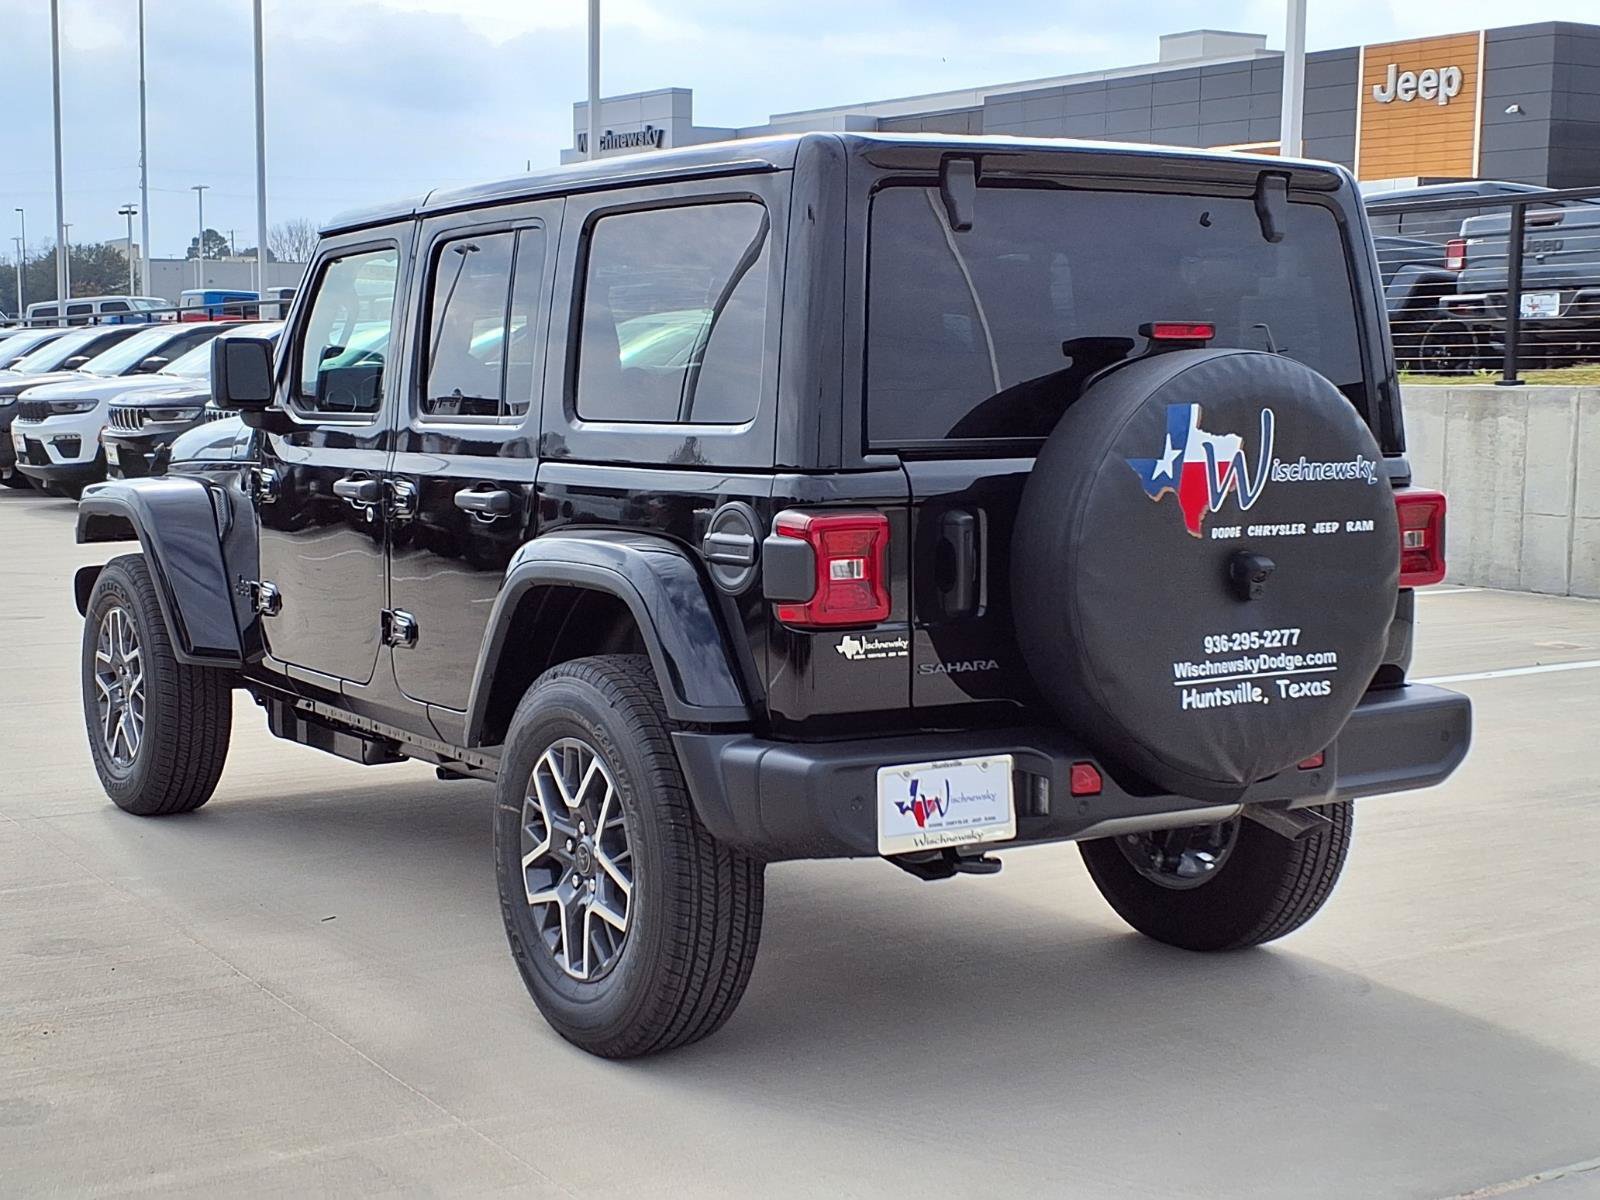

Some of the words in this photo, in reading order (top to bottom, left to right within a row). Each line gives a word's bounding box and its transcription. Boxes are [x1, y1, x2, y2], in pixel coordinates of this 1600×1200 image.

[1373, 64, 1462, 106] Jeep
[577, 124, 664, 153] Wchnewsky
[1202, 408, 1378, 512] Wischnewsky
[1211, 526, 1242, 540] DODGE
[1247, 522, 1306, 537] CHRYSLER
[1312, 521, 1339, 535] JEEP
[1346, 520, 1374, 532] RAM
[1204, 628, 1301, 654] 936-295-2277
[919, 659, 1000, 676] SAHARA
[1173, 652, 1337, 679] WischnewskyDodge.com
[1182, 682, 1269, 710] Huntsville,
[1276, 679, 1331, 699] Texas
